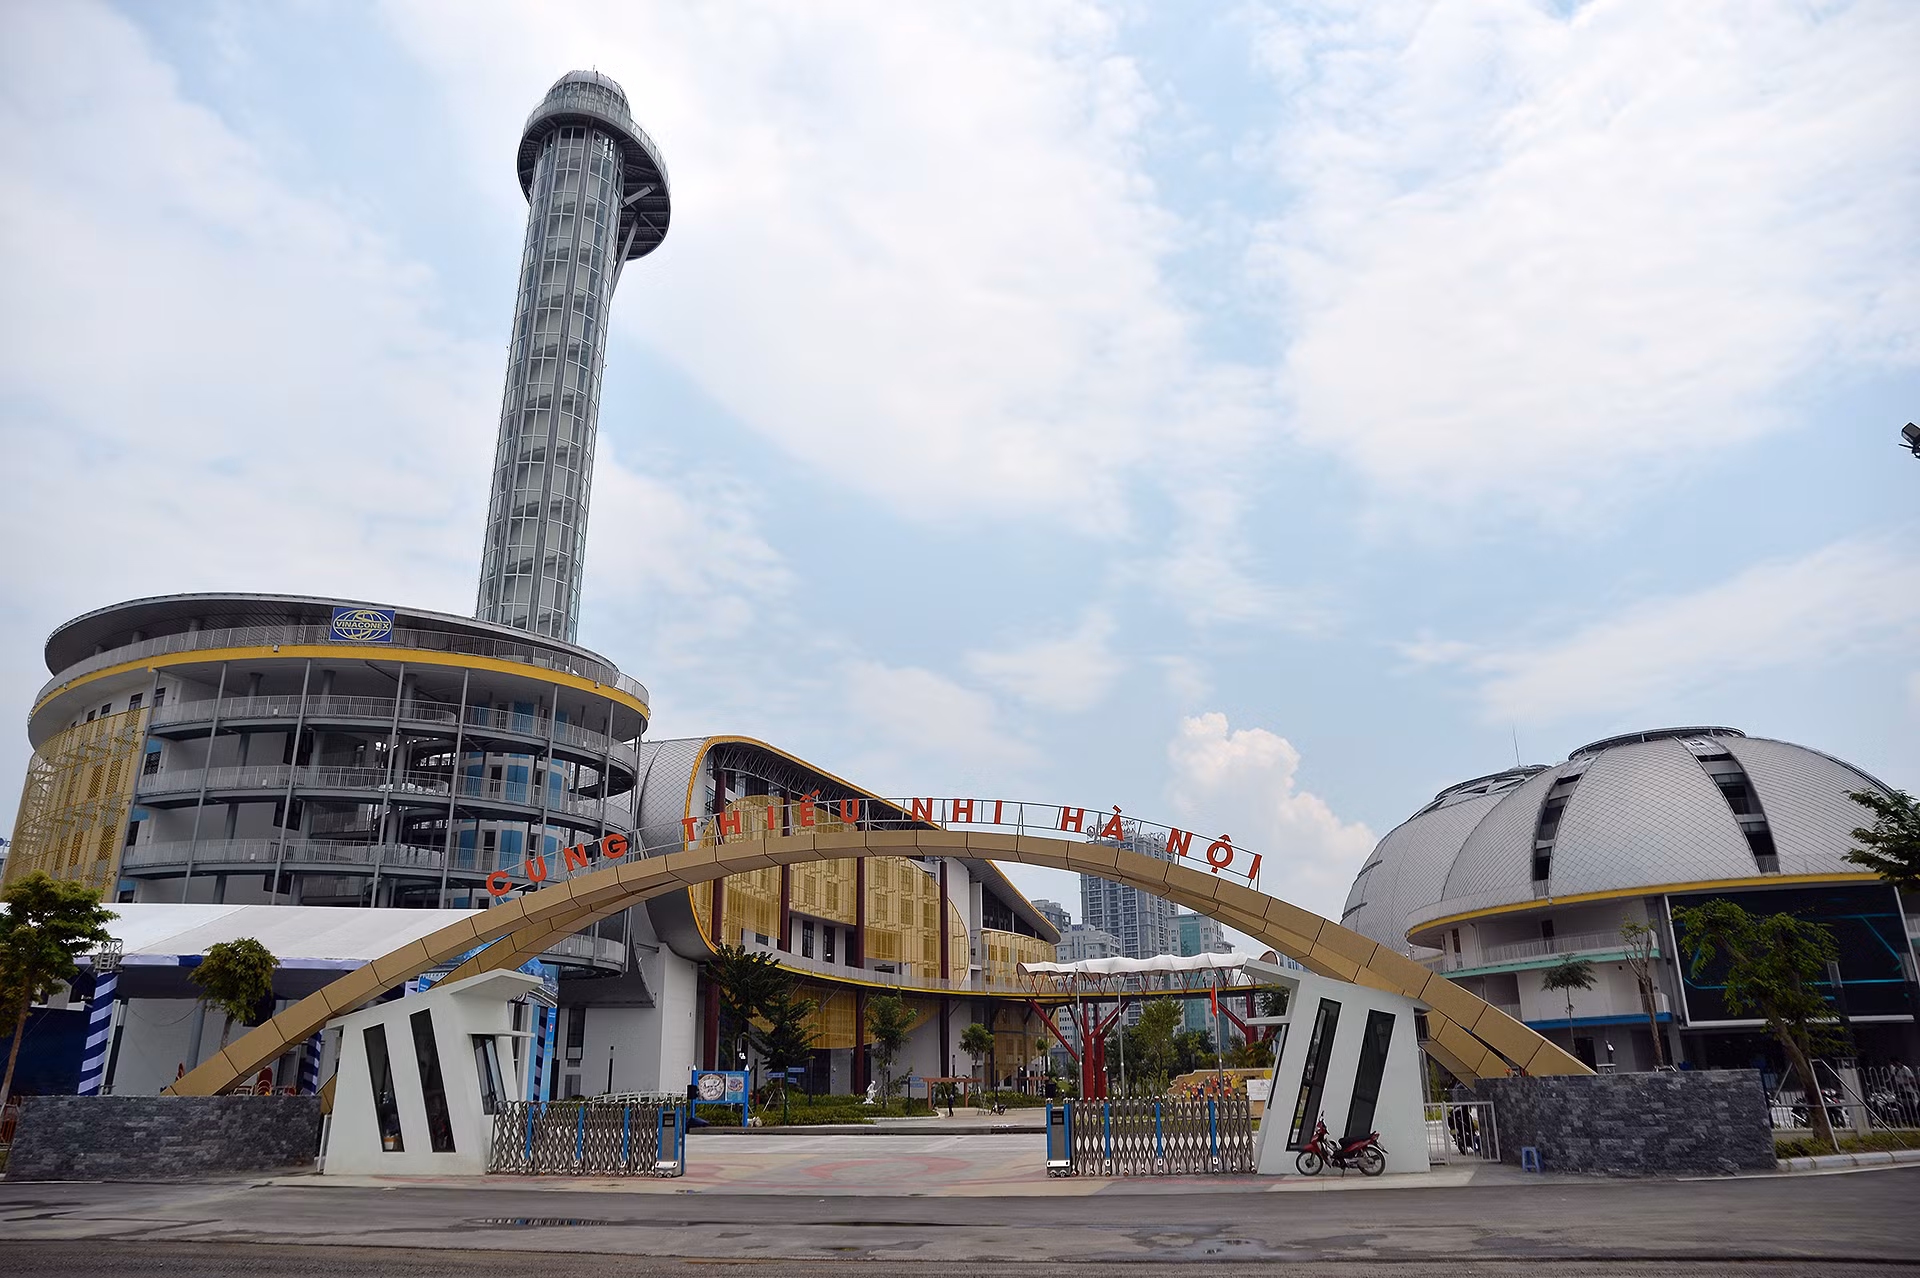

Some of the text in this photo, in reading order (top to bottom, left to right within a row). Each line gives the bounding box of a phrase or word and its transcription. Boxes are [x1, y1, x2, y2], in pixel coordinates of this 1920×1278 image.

[336, 621, 389, 629] VINACONEX
[486, 789, 1262, 897] CUNG THIẾU NHI HÀ NỘI
